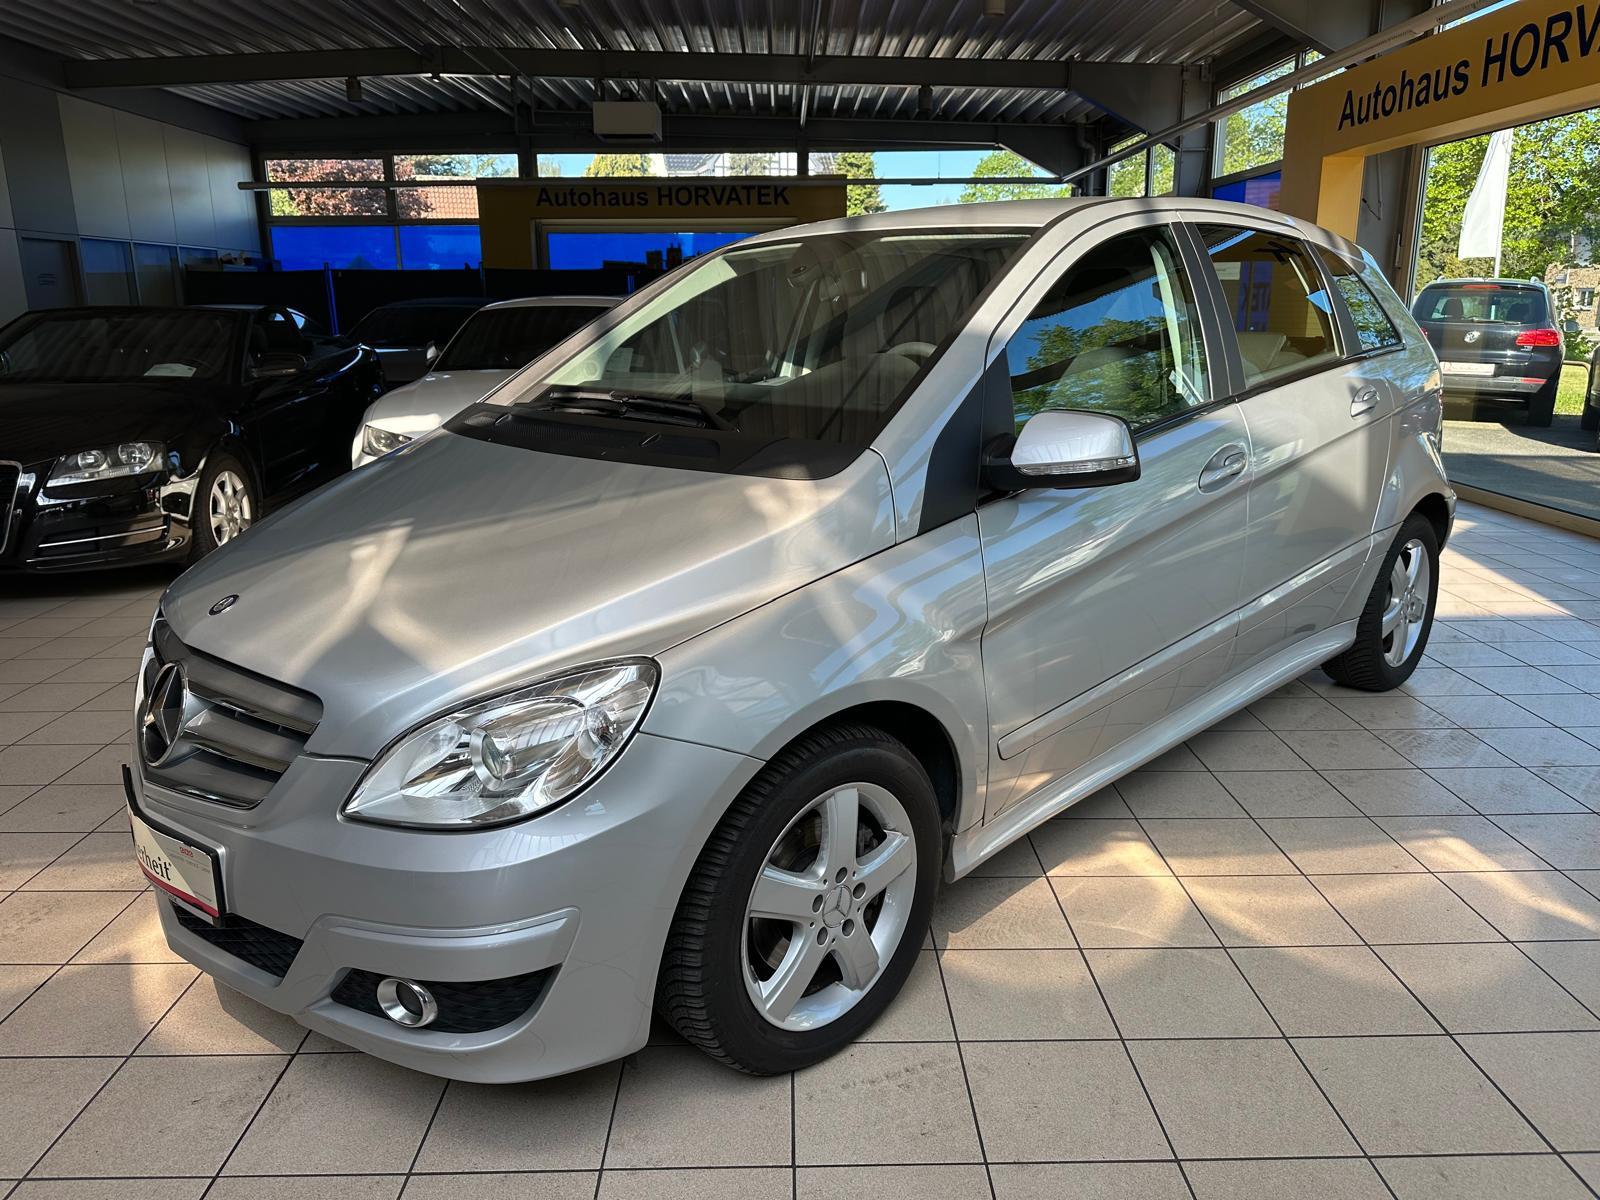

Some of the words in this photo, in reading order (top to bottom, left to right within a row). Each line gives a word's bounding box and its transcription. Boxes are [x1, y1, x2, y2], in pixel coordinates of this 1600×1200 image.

[1338, 58, 1470, 131] Autohaus
[1481, 4, 1600, 88] HORV
[536, 187, 649, 207] Autohaus
[657, 185, 790, 206] HORVATEK
